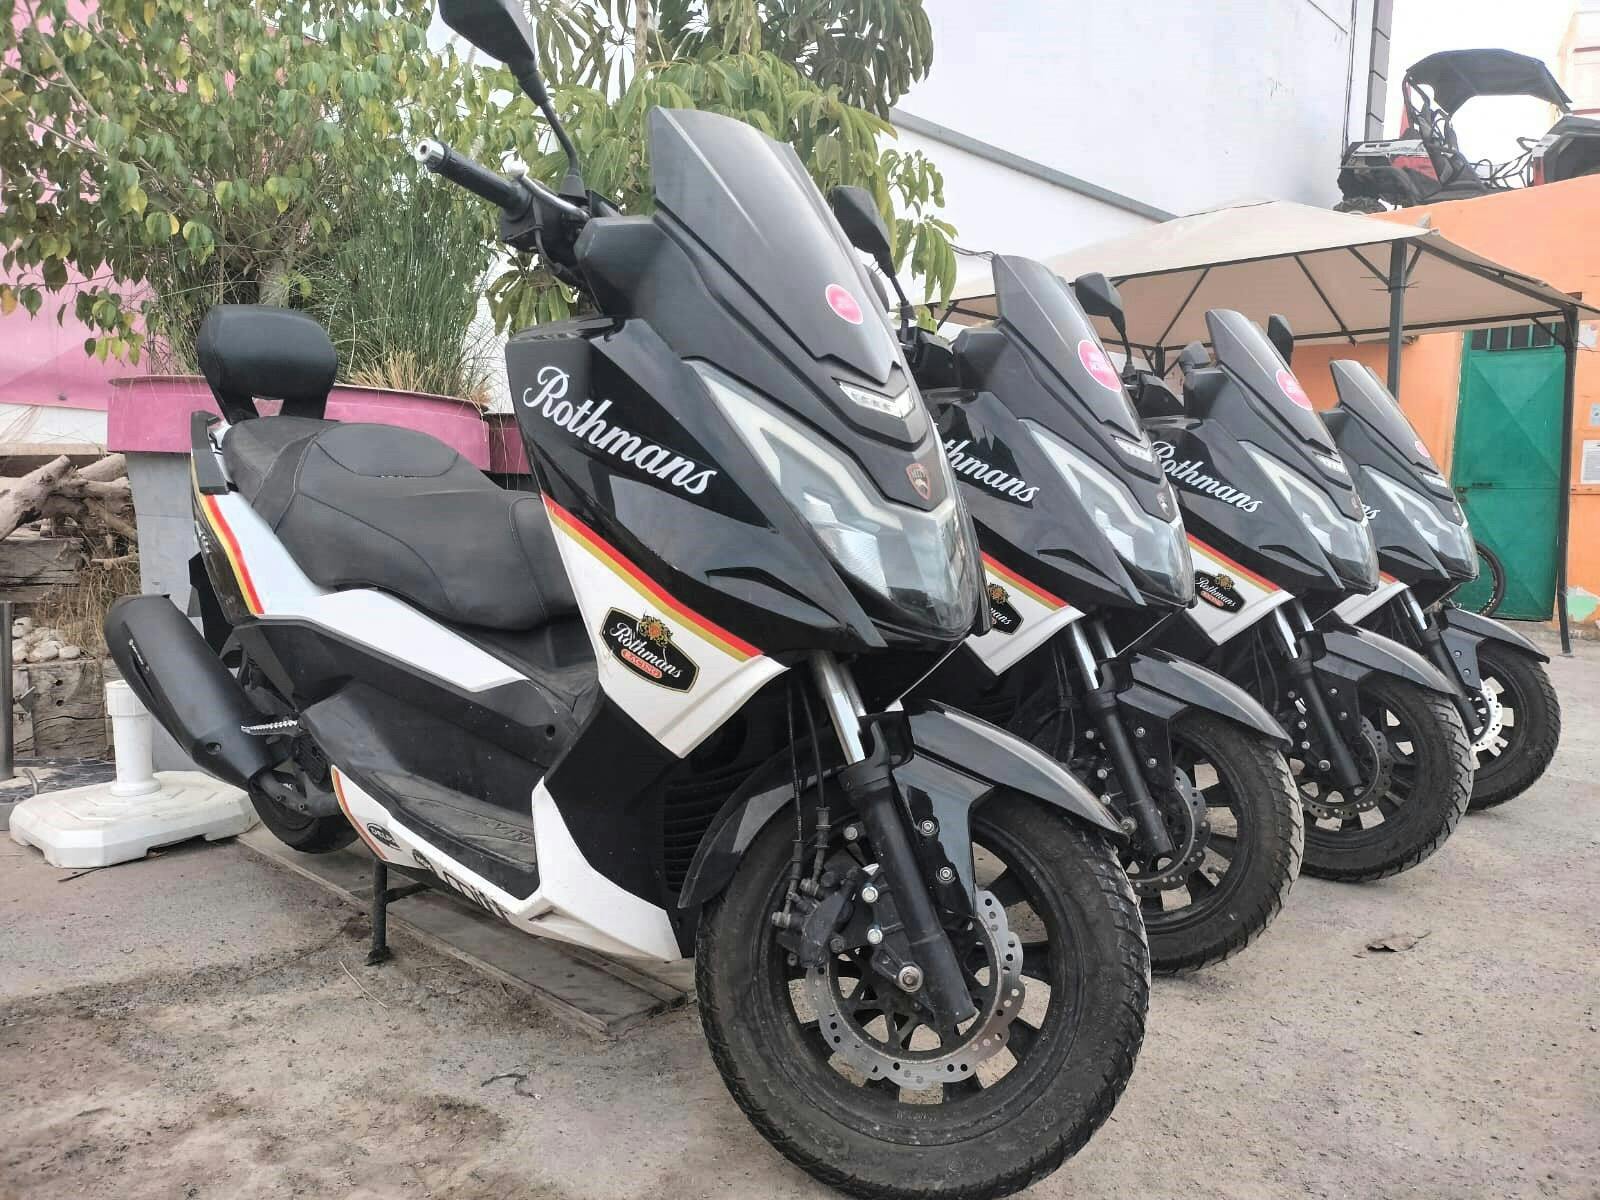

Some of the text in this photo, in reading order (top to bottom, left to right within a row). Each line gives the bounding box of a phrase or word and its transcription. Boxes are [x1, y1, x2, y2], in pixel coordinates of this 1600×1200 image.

[523, 366, 717, 494] Rothmans
[943, 439, 1040, 502] thmans
[610, 622, 683, 678] Rothmans
